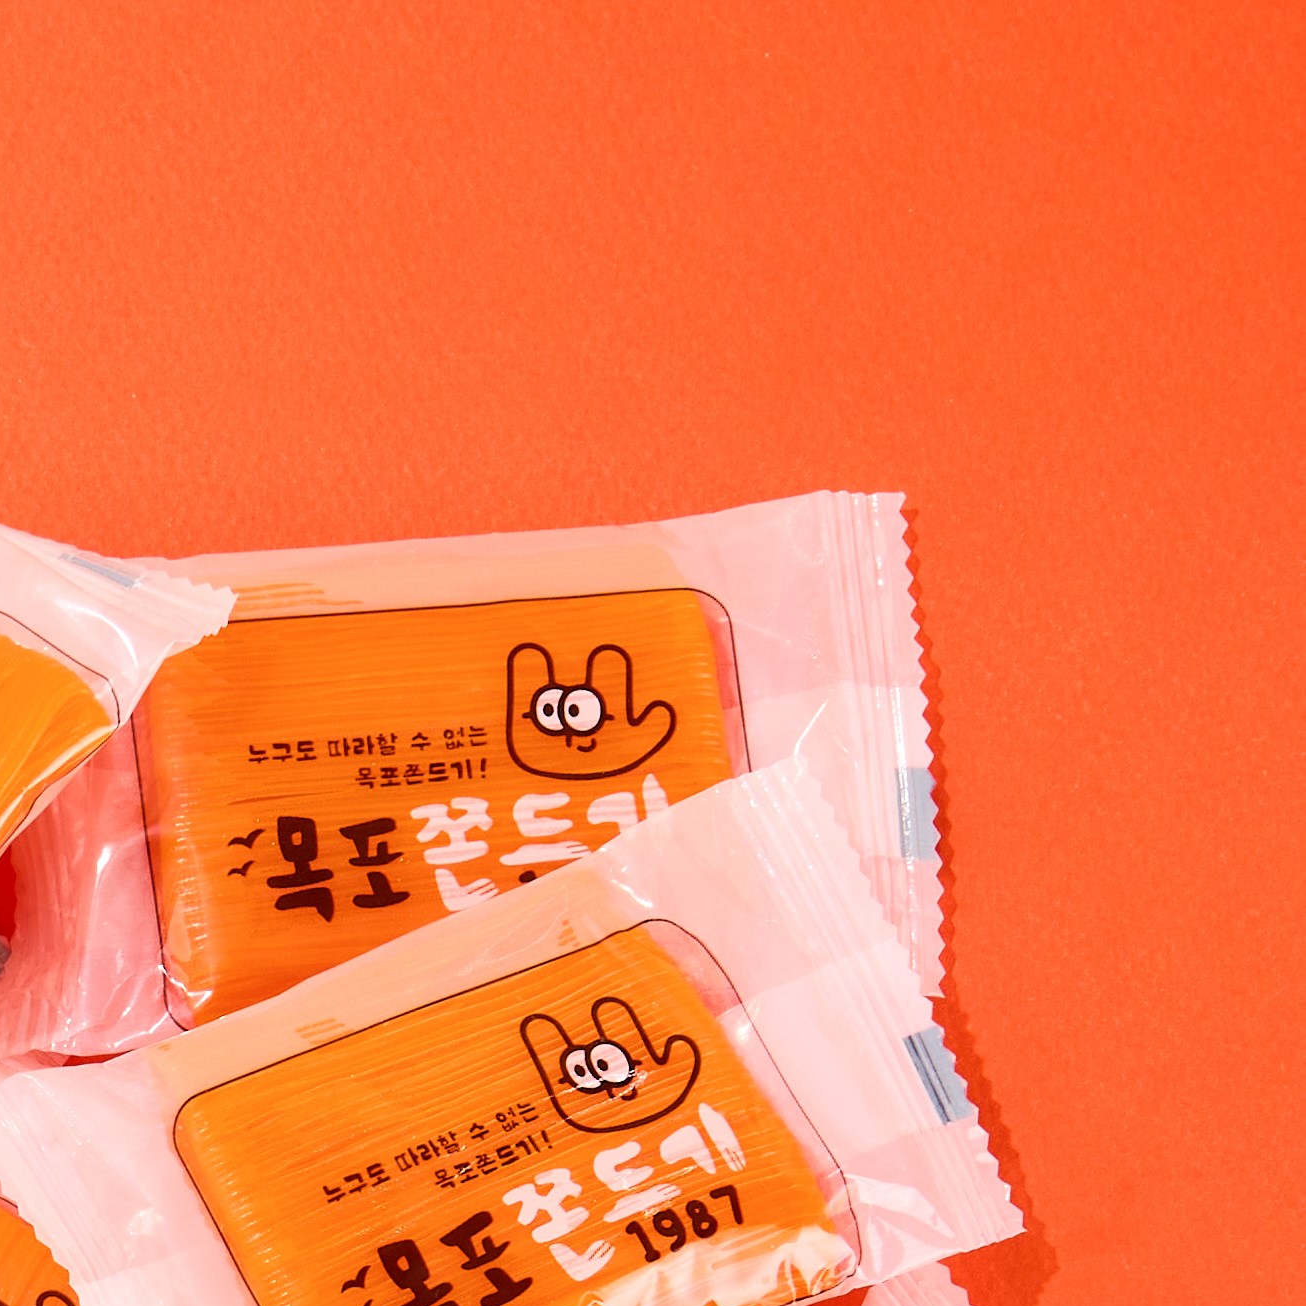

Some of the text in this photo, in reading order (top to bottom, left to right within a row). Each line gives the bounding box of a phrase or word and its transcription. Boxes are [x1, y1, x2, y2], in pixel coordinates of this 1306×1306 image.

[247, 724, 489, 766] 누구도 따라할 수 없는
[322, 1100, 540, 1204] 누구도 따라할 수 없는
[625, 1183, 746, 1264] 1987
